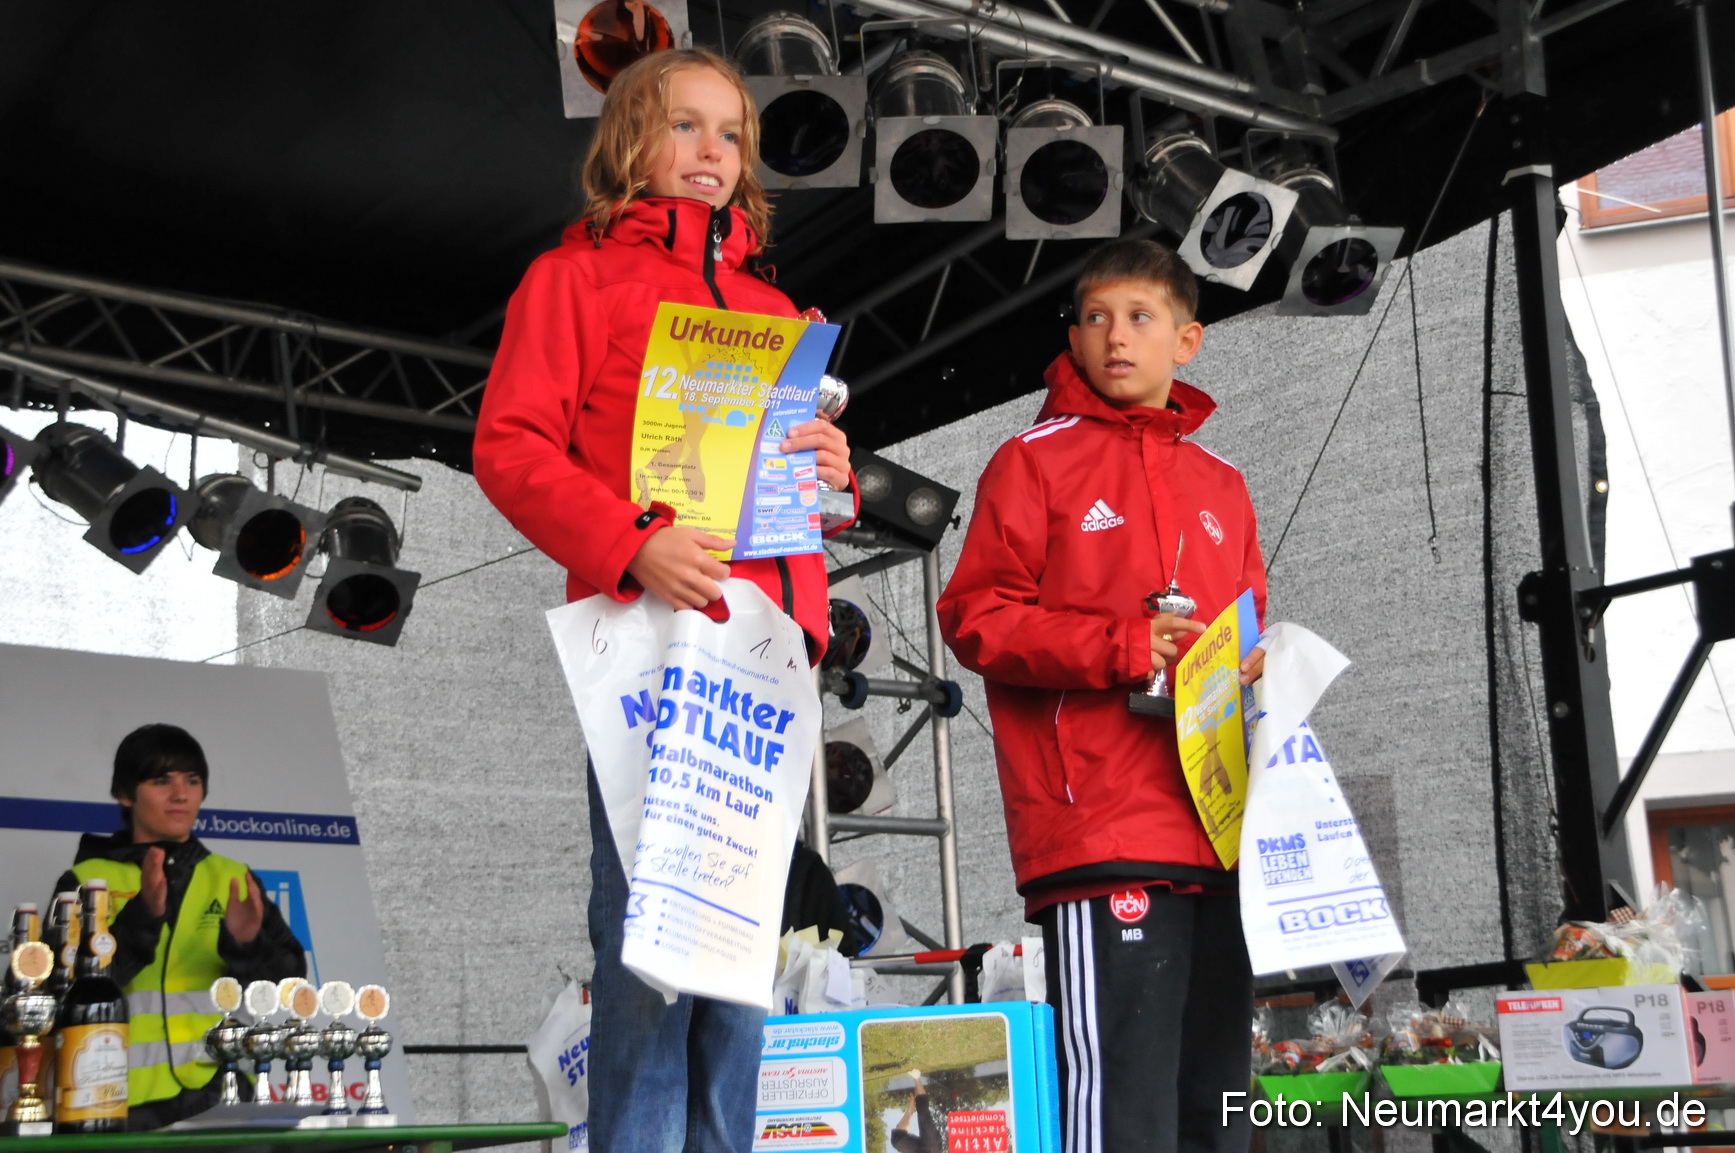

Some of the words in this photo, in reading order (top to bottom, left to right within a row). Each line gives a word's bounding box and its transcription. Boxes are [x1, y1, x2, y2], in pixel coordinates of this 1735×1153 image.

[669, 315, 785, 352] Urkunde
[642, 364, 679, 400] 12.
[678, 374, 756, 397] Neumarkter
[758, 382, 818, 403] Stadtlauf
[684, 391, 697, 402] 18.
[701, 393, 756, 408] September
[759, 399, 781, 409] 2011
[664, 422, 687, 430] Jugend
[641, 433, 663, 441] Ulrich
[658, 462, 697, 470] Gesamtplatz
[1081, 515, 1125, 532] adidas
[752, 532, 808, 544] BOCK
[743, 544, 818, 557] www.stadtlauf-neumarkt.de
[1182, 625, 1233, 687] Urkunde
[650, 744, 774, 803] Halbmarathon
[648, 766, 692, 789] 10,5
[695, 777, 721, 803] km
[725, 791, 760, 820] Lauf
[684, 803, 698, 817] Sie
[701, 812, 720, 827] uns.
[1315, 818, 1357, 830] Unterst
[666, 814, 695, 831] einen
[697, 826, 724, 842] guten
[725, 835, 759, 859] Zweck!
[1317, 830, 1353, 842] Laufen
[1257, 832, 1306, 855] DKMS
[663, 844, 702, 862] wollen
[1260, 850, 1309, 872] LEBEN
[1264, 866, 1313, 886] SPENDEN
[1115, 898, 1145, 913] FCN
[1278, 897, 1389, 934] BOCK
[1121, 928, 1144, 941] MB
[1507, 1001, 1560, 1011] TELEFUNKEN
[1634, 994, 1670, 1008] P18
[1697, 1000, 1726, 1014] P18
[773, 1025, 840, 1035] www.slackstar.de
[768, 1036, 840, 1051] slackstar
[761, 1077, 829, 1090] AUSRÜSTER
[761, 1088, 829, 1101] OFFIZIELLER
[950, 1113, 1005, 1123] Komplettset
[950, 1125, 1006, 1136] slackline
[954, 1137, 1003, 1151] Aktiv
